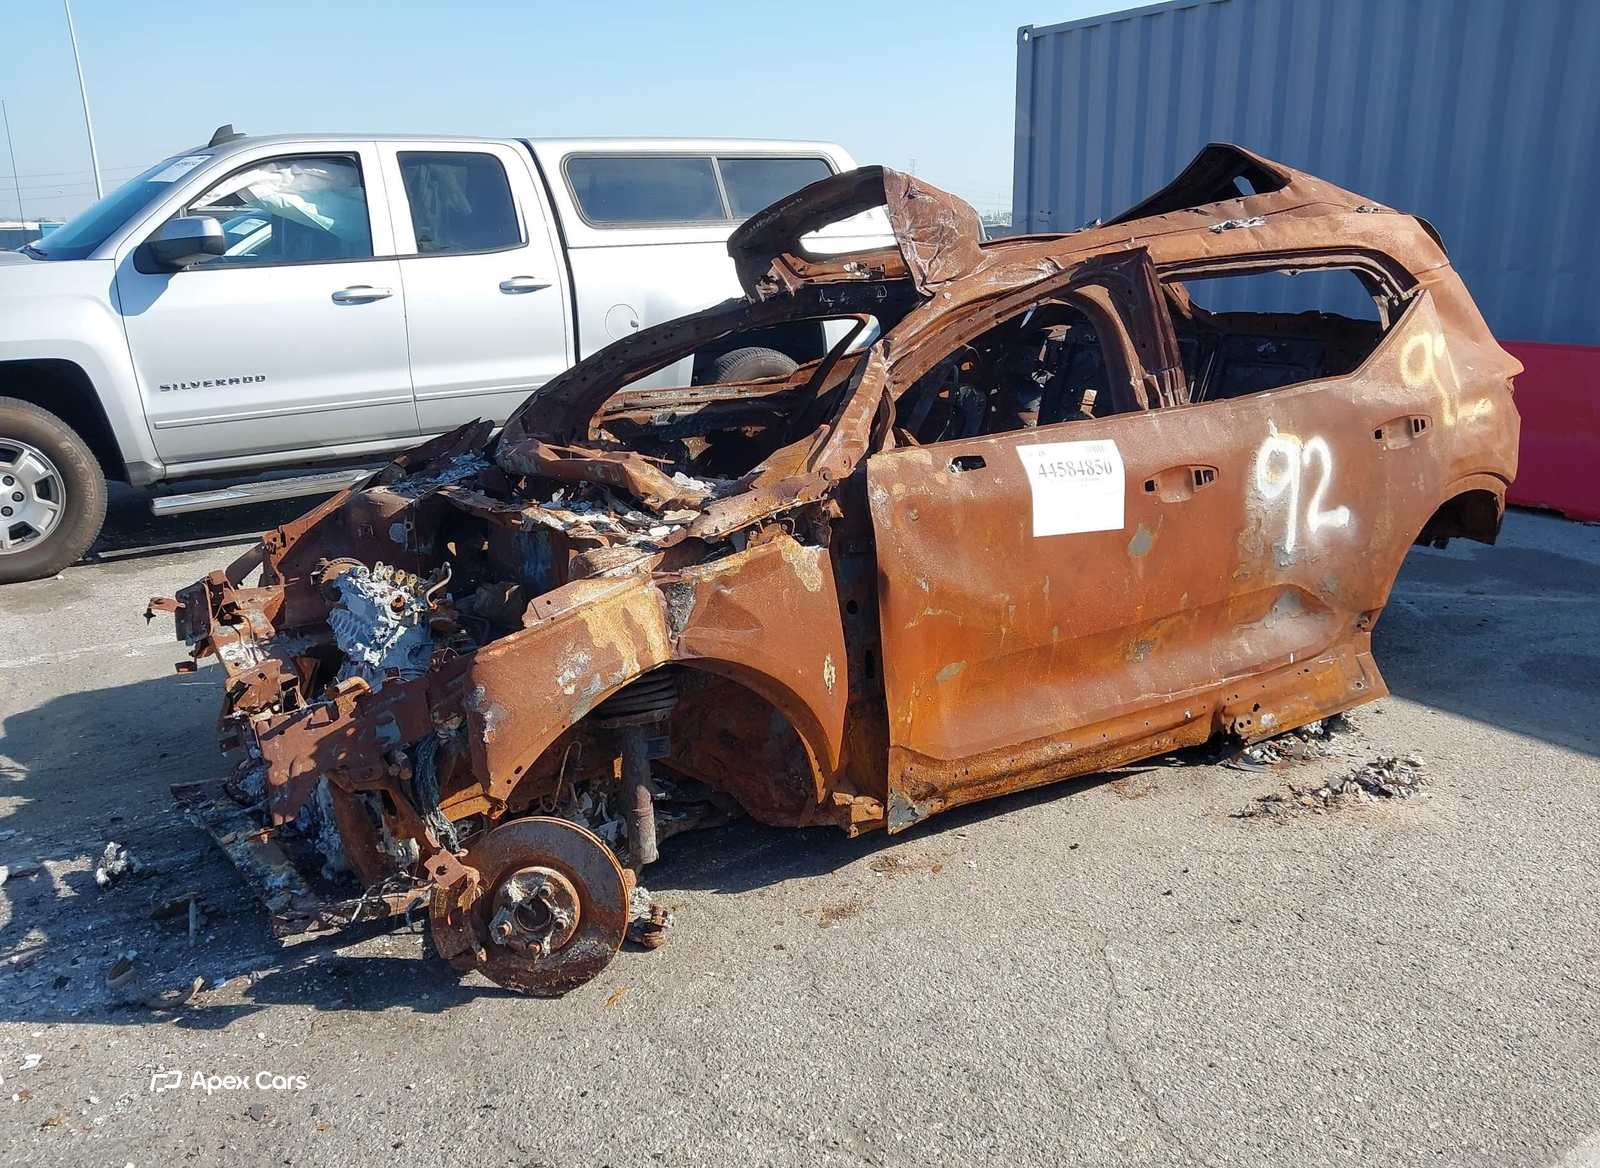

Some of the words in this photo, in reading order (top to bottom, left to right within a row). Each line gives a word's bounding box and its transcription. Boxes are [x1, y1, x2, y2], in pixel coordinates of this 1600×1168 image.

[159, 375, 266, 392] SILVERADO
[1037, 458, 1113, 479] 44584850
[1256, 436, 1351, 554] 92
